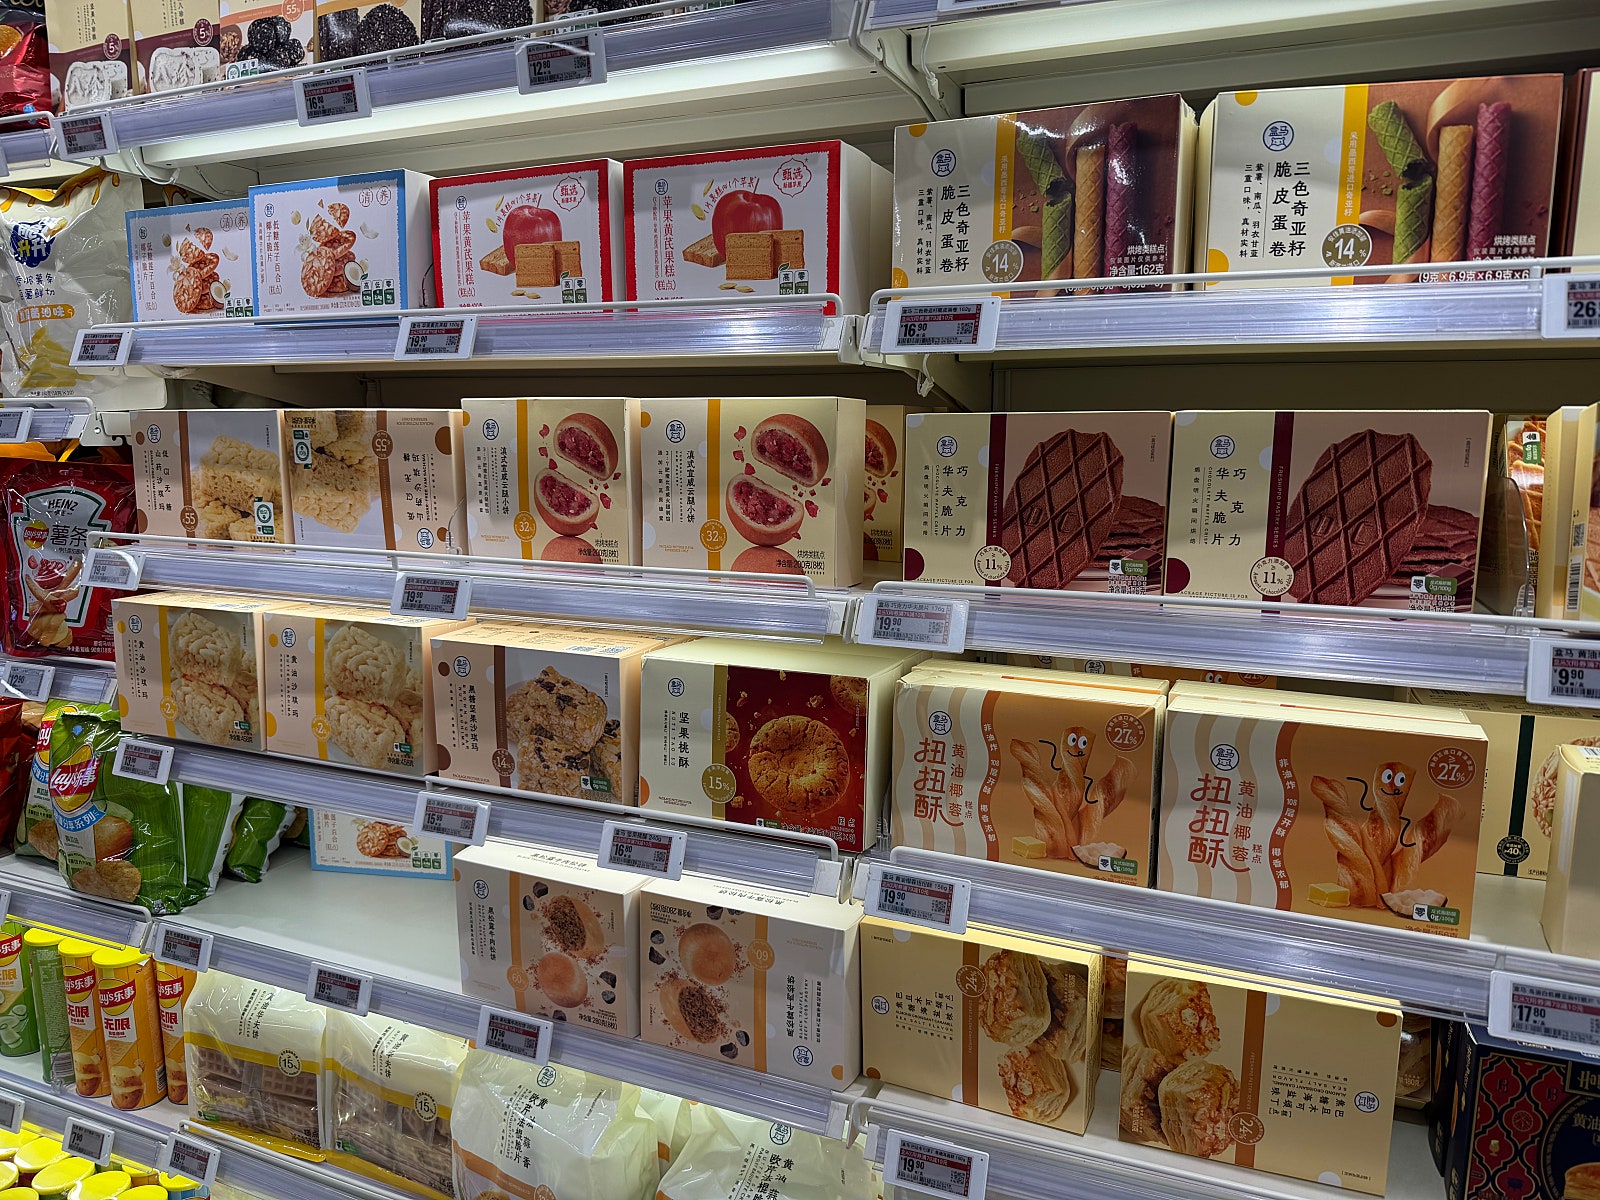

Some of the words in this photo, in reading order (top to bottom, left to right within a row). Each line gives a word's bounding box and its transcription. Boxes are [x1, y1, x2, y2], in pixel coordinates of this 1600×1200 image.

[782, 168, 803, 181] 甄选
[662, 196, 675, 278] 苹果黄芪果糕
[940, 185, 955, 273] 脆皮蛋卷
[955, 184, 970, 272] 三色奇亚籽
[1269, 161, 1292, 256] 脆皮蛋卷
[1288, 161, 1310, 257] 三色奇亚籽
[462, 211, 475, 286] 苹果黄芪果糕
[991, 255, 1009, 274] 14
[1109, 263, 1165, 276] 净含量:162克
[1333, 238, 1355, 259] 14
[1493, 235, 1536, 246] 烘烤类糕点
[457, 287, 476, 298] (糕点)
[654, 279, 677, 291] (糕点)
[48, 499, 79, 511] HEINZ
[155, 450, 165, 511] 山药沙琪玛
[412, 453, 423, 521] 山药沙琪玛
[686, 450, 696, 523] 滇式宣威云腿小饼
[941, 464, 954, 537] 华夫脆片
[955, 465, 968, 537] 巧克力
[1211, 467, 1229, 546] 华夫脆片
[1228, 467, 1247, 546] 巧克力
[50, 524, 88, 547] 薯条
[1263, 572, 1284, 585] 11%
[138, 640, 148, 699] 黄油沙琪玛
[290, 655, 299, 718] 黄油沙琪玛
[678, 711, 690, 769] 坚果桃酥
[1113, 727, 1138, 745] 27%
[708, 776, 730, 791] 15%
[914, 737, 964, 827] 扭扭酥
[948, 743, 966, 817] 黄油椰蓉
[1278, 758, 1296, 789] 非油炸
[1437, 763, 1466, 782] 27%
[1188, 773, 1250, 872] 扭扭酥
[1232, 780, 1256, 862] 黄油椰蓉
[1252, 843, 1262, 864] 糕点
[1272, 847, 1289, 890] 椰香浓郁
[883, 889, 905, 904] 19.90
[488, 906, 497, 961] 黑松露牛肉松饼
[104, 1017, 131, 1030] 无限
[786, 975, 796, 1037] 黑松露牛肉松饼
[1518, 1005, 1546, 1022] 17.80
